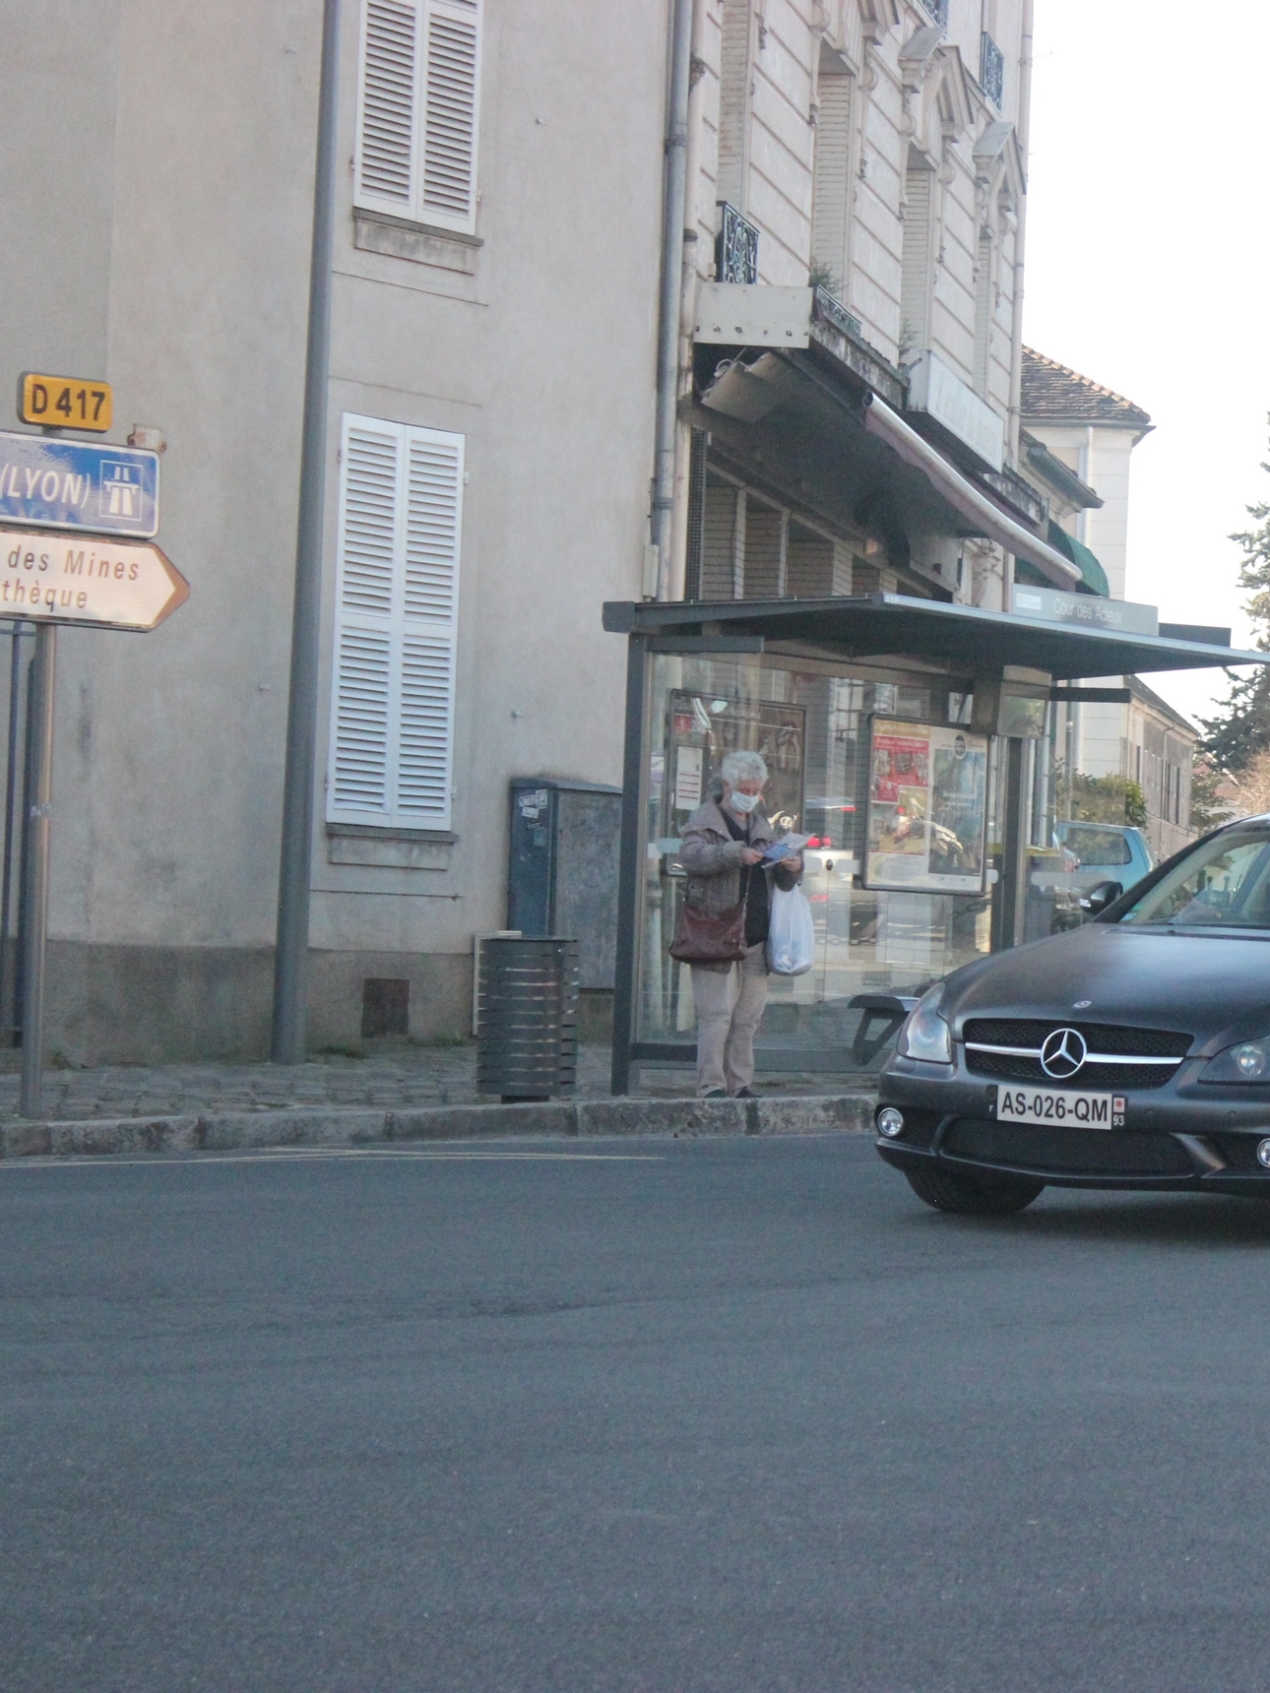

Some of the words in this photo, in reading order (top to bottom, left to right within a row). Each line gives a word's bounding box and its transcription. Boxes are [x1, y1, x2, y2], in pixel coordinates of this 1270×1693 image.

[8, 544, 49, 571] des
[64, 549, 139, 580] Mines
[1053, 597, 1074, 616] Cour
[1076, 603, 1093, 619] des
[1001, 1092, 1108, 1122] AS-026-QM
[1113, 1115, 1125, 1126] 93
